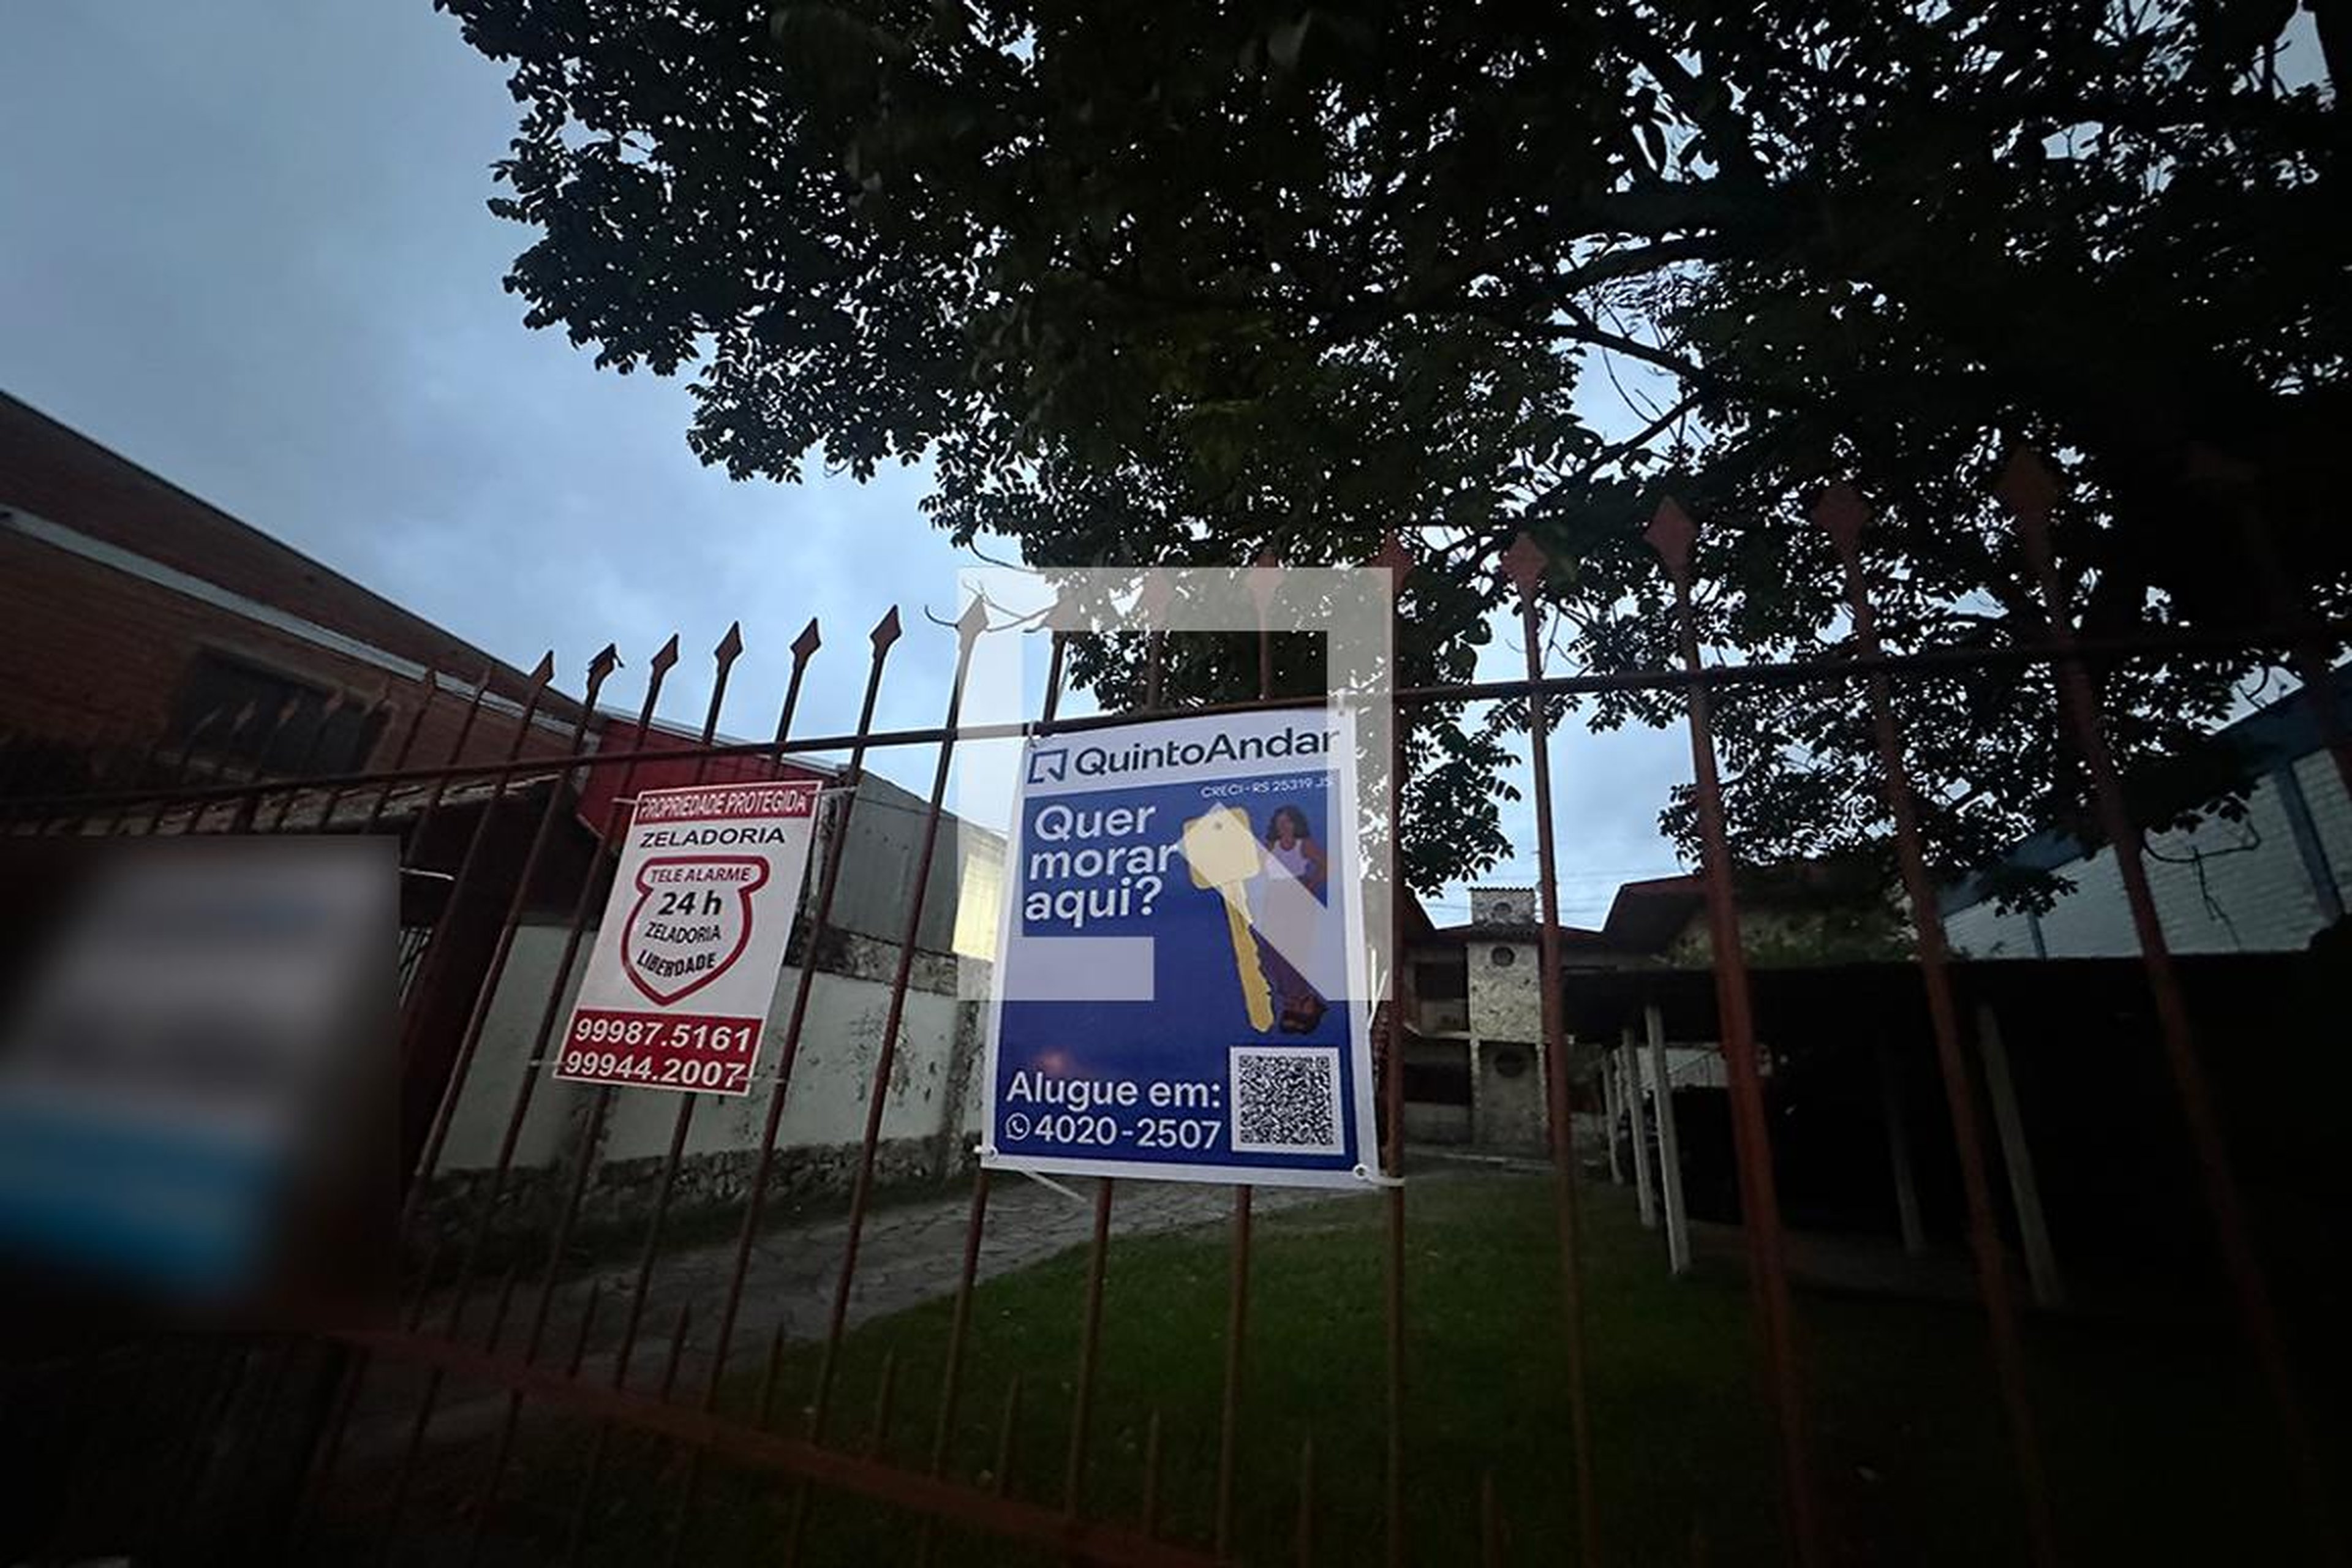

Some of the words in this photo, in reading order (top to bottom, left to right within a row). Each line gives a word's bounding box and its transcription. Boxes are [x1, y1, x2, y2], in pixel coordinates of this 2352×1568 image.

[1075, 726, 1340, 777] QuintoAndar
[638, 794, 726, 820] PROPRIEDADE
[725, 790, 807, 813] PROTEGIDA
[1035, 804, 1156, 842] Quer
[639, 827, 785, 848] ZELADORIA
[650, 869, 684, 883] TELE
[685, 867, 752, 882] ALARME
[1029, 843, 1178, 881] morar
[658, 892, 695, 916] 24
[702, 890, 722, 915] h
[1025, 876, 1163, 929] aqui?
[645, 921, 722, 944] ZELADORIA
[636, 949, 717, 978] LIBERDADE
[575, 1017, 752, 1053] 99987.5161
[564, 1050, 747, 1088] 99944.2007
[1006, 1071, 1137, 1112] Alugue
[1148, 1080, 1221, 1108] em:
[1033, 1114, 1223, 1150] 4020-2507
